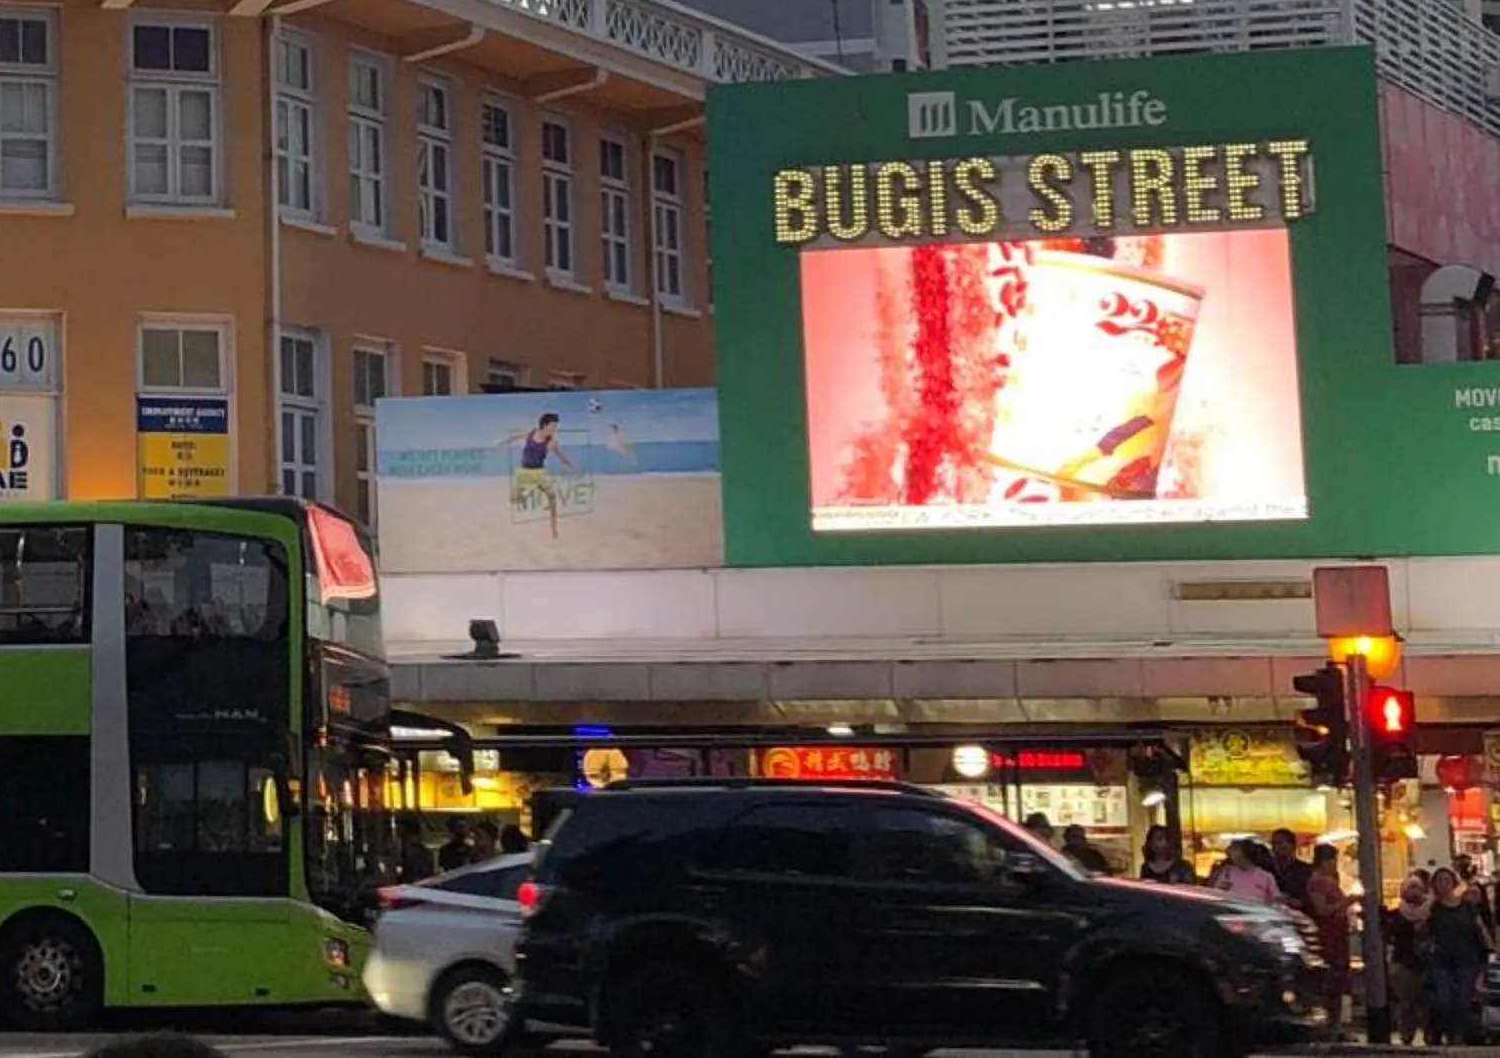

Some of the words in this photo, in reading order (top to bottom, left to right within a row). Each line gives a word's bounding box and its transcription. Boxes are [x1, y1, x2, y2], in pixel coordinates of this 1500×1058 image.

[965, 90, 1167, 136] Manulife
[773, 156, 999, 243] BUGIS
[1027, 140, 1309, 232] STREET
